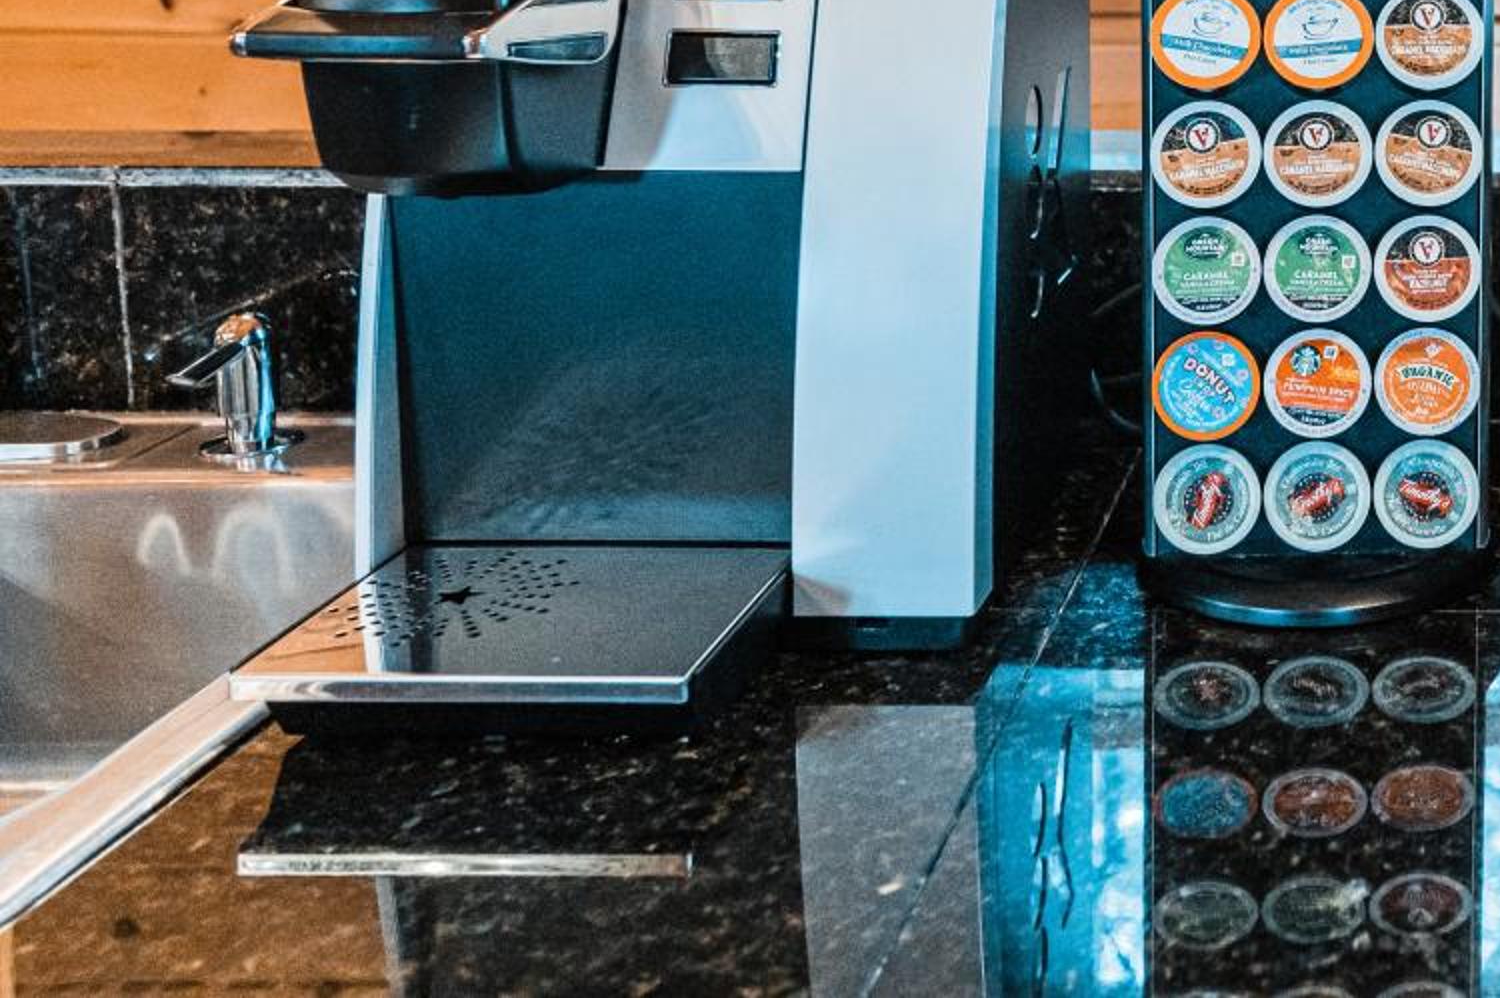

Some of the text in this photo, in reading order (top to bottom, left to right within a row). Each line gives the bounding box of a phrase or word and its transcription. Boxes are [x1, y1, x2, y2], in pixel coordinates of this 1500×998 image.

[1183, 271, 1228, 281] CARAMEL
[1294, 270, 1337, 279] CARAMEL
[1183, 357, 1235, 404] DONUT
[1401, 364, 1455, 387] ORGANIC
[1283, 381, 1327, 394] PUMPKIN
